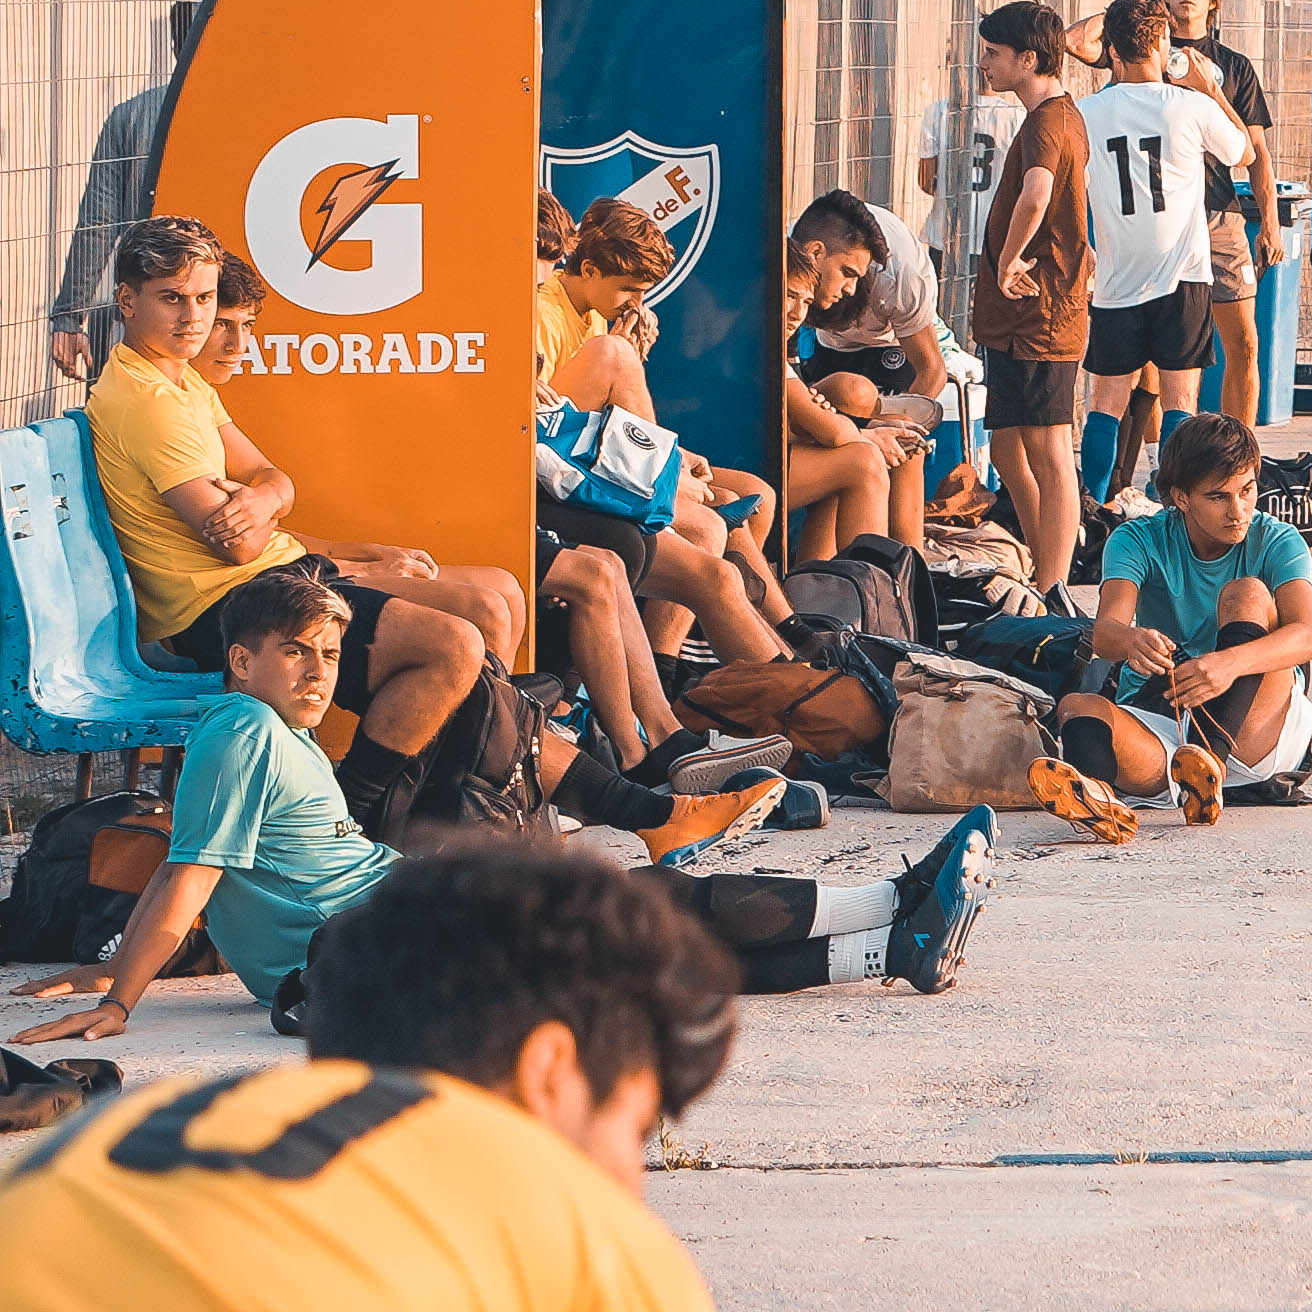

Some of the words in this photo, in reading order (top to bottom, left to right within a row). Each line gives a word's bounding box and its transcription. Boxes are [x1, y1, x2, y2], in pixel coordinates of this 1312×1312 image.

[1106, 135, 1166, 216] 11
[244, 114, 424, 315] G
[653, 198, 680, 221] de
[232, 332, 486, 375] ATORADE
